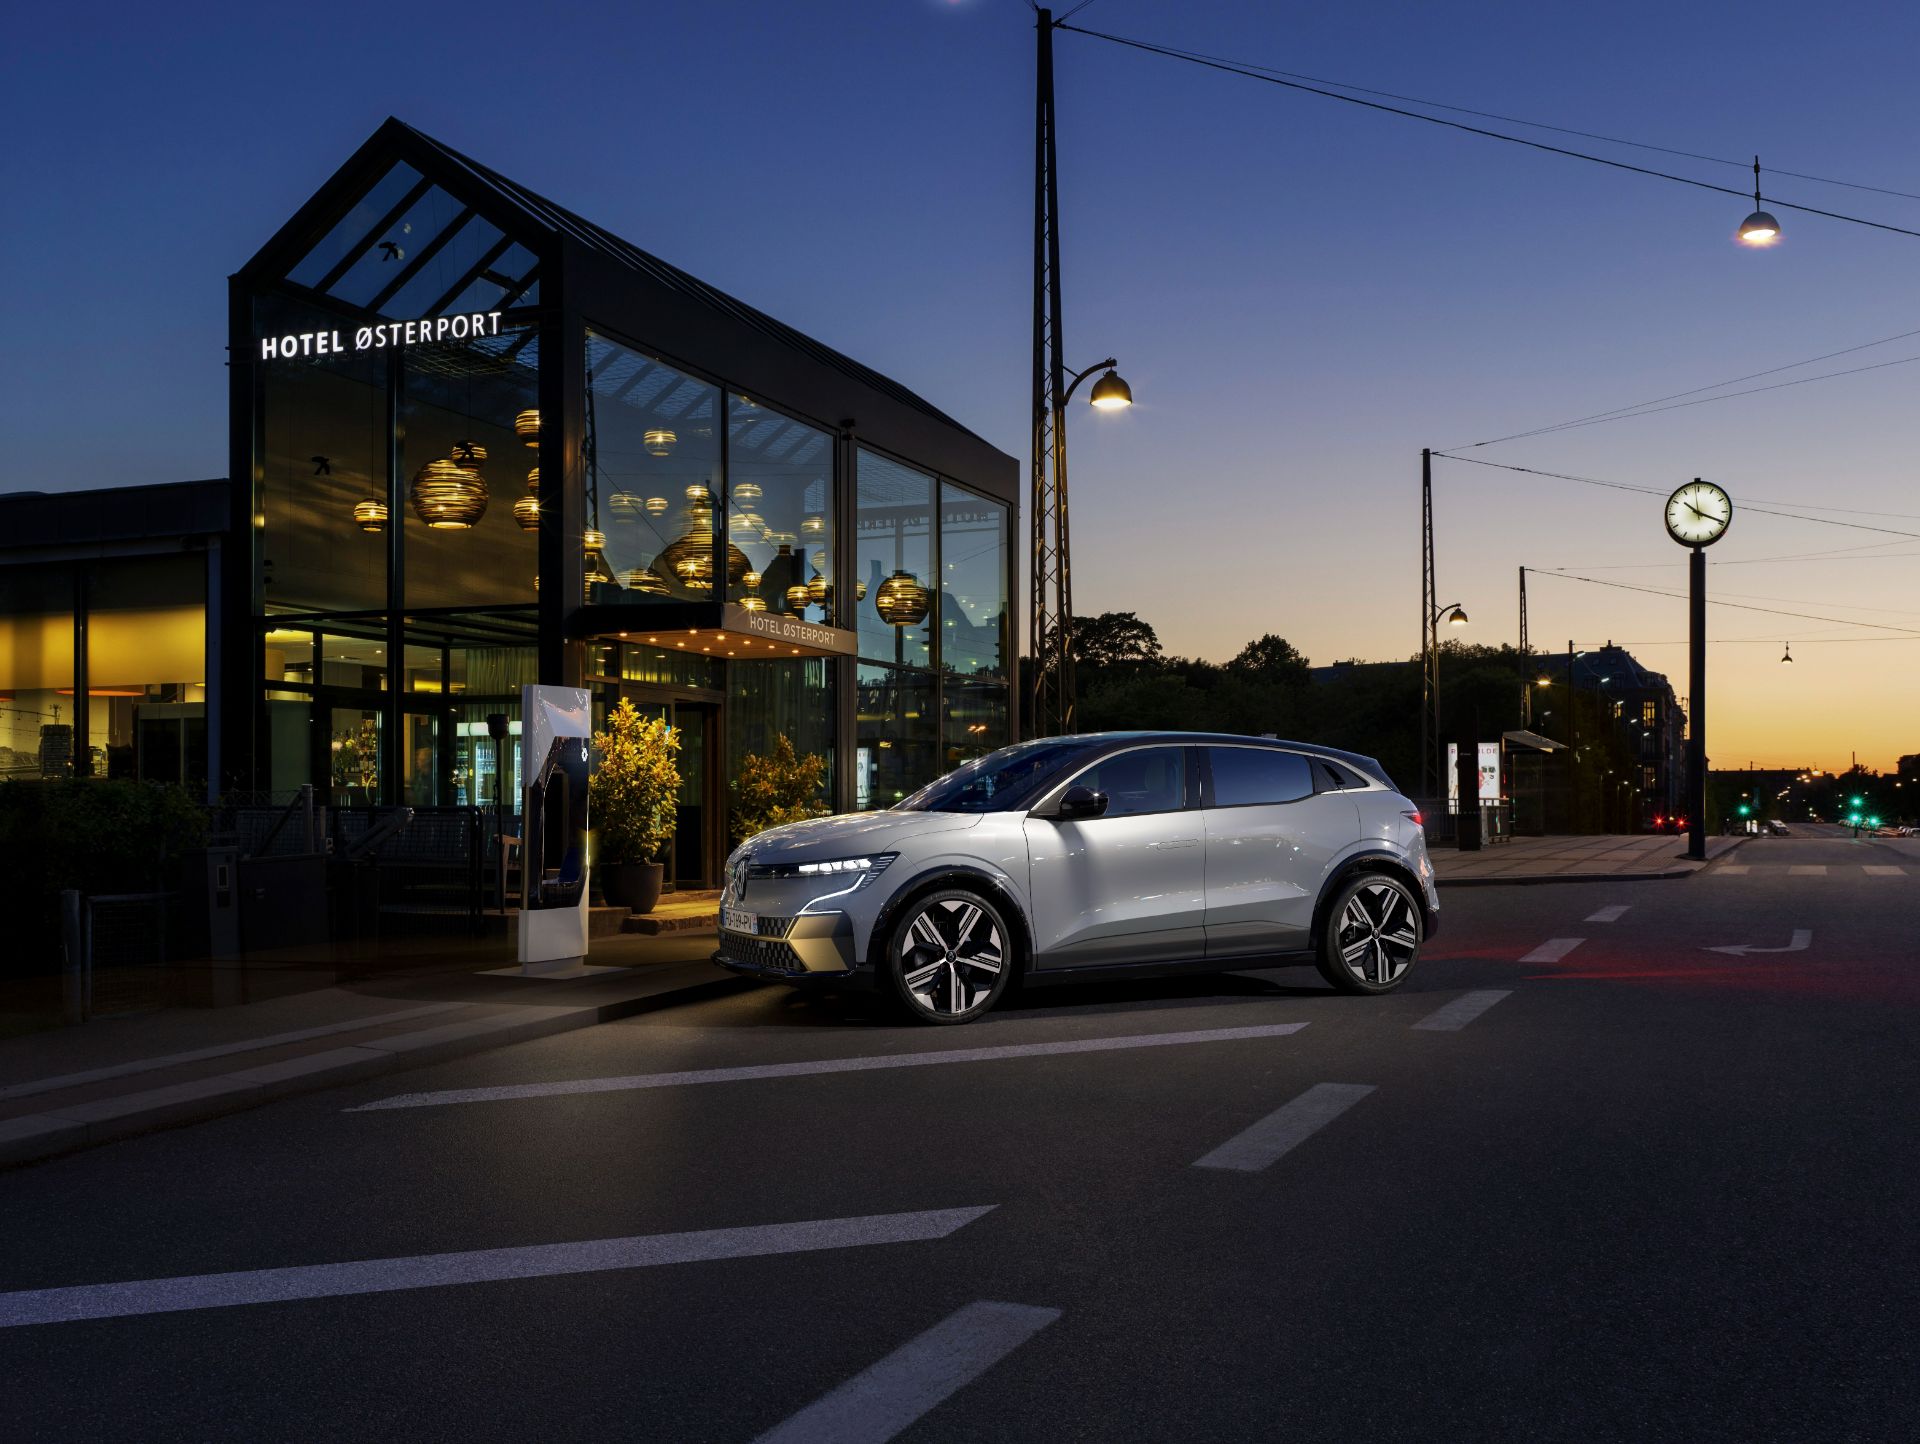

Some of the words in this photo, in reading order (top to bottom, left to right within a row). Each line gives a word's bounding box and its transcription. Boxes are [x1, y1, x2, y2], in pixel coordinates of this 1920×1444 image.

[262, 330, 344, 360] HOTEL
[355, 311, 502, 350] ØSTERPORT
[750, 615, 781, 635] HOTEL
[783, 623, 836, 646] ØSTERPORT
